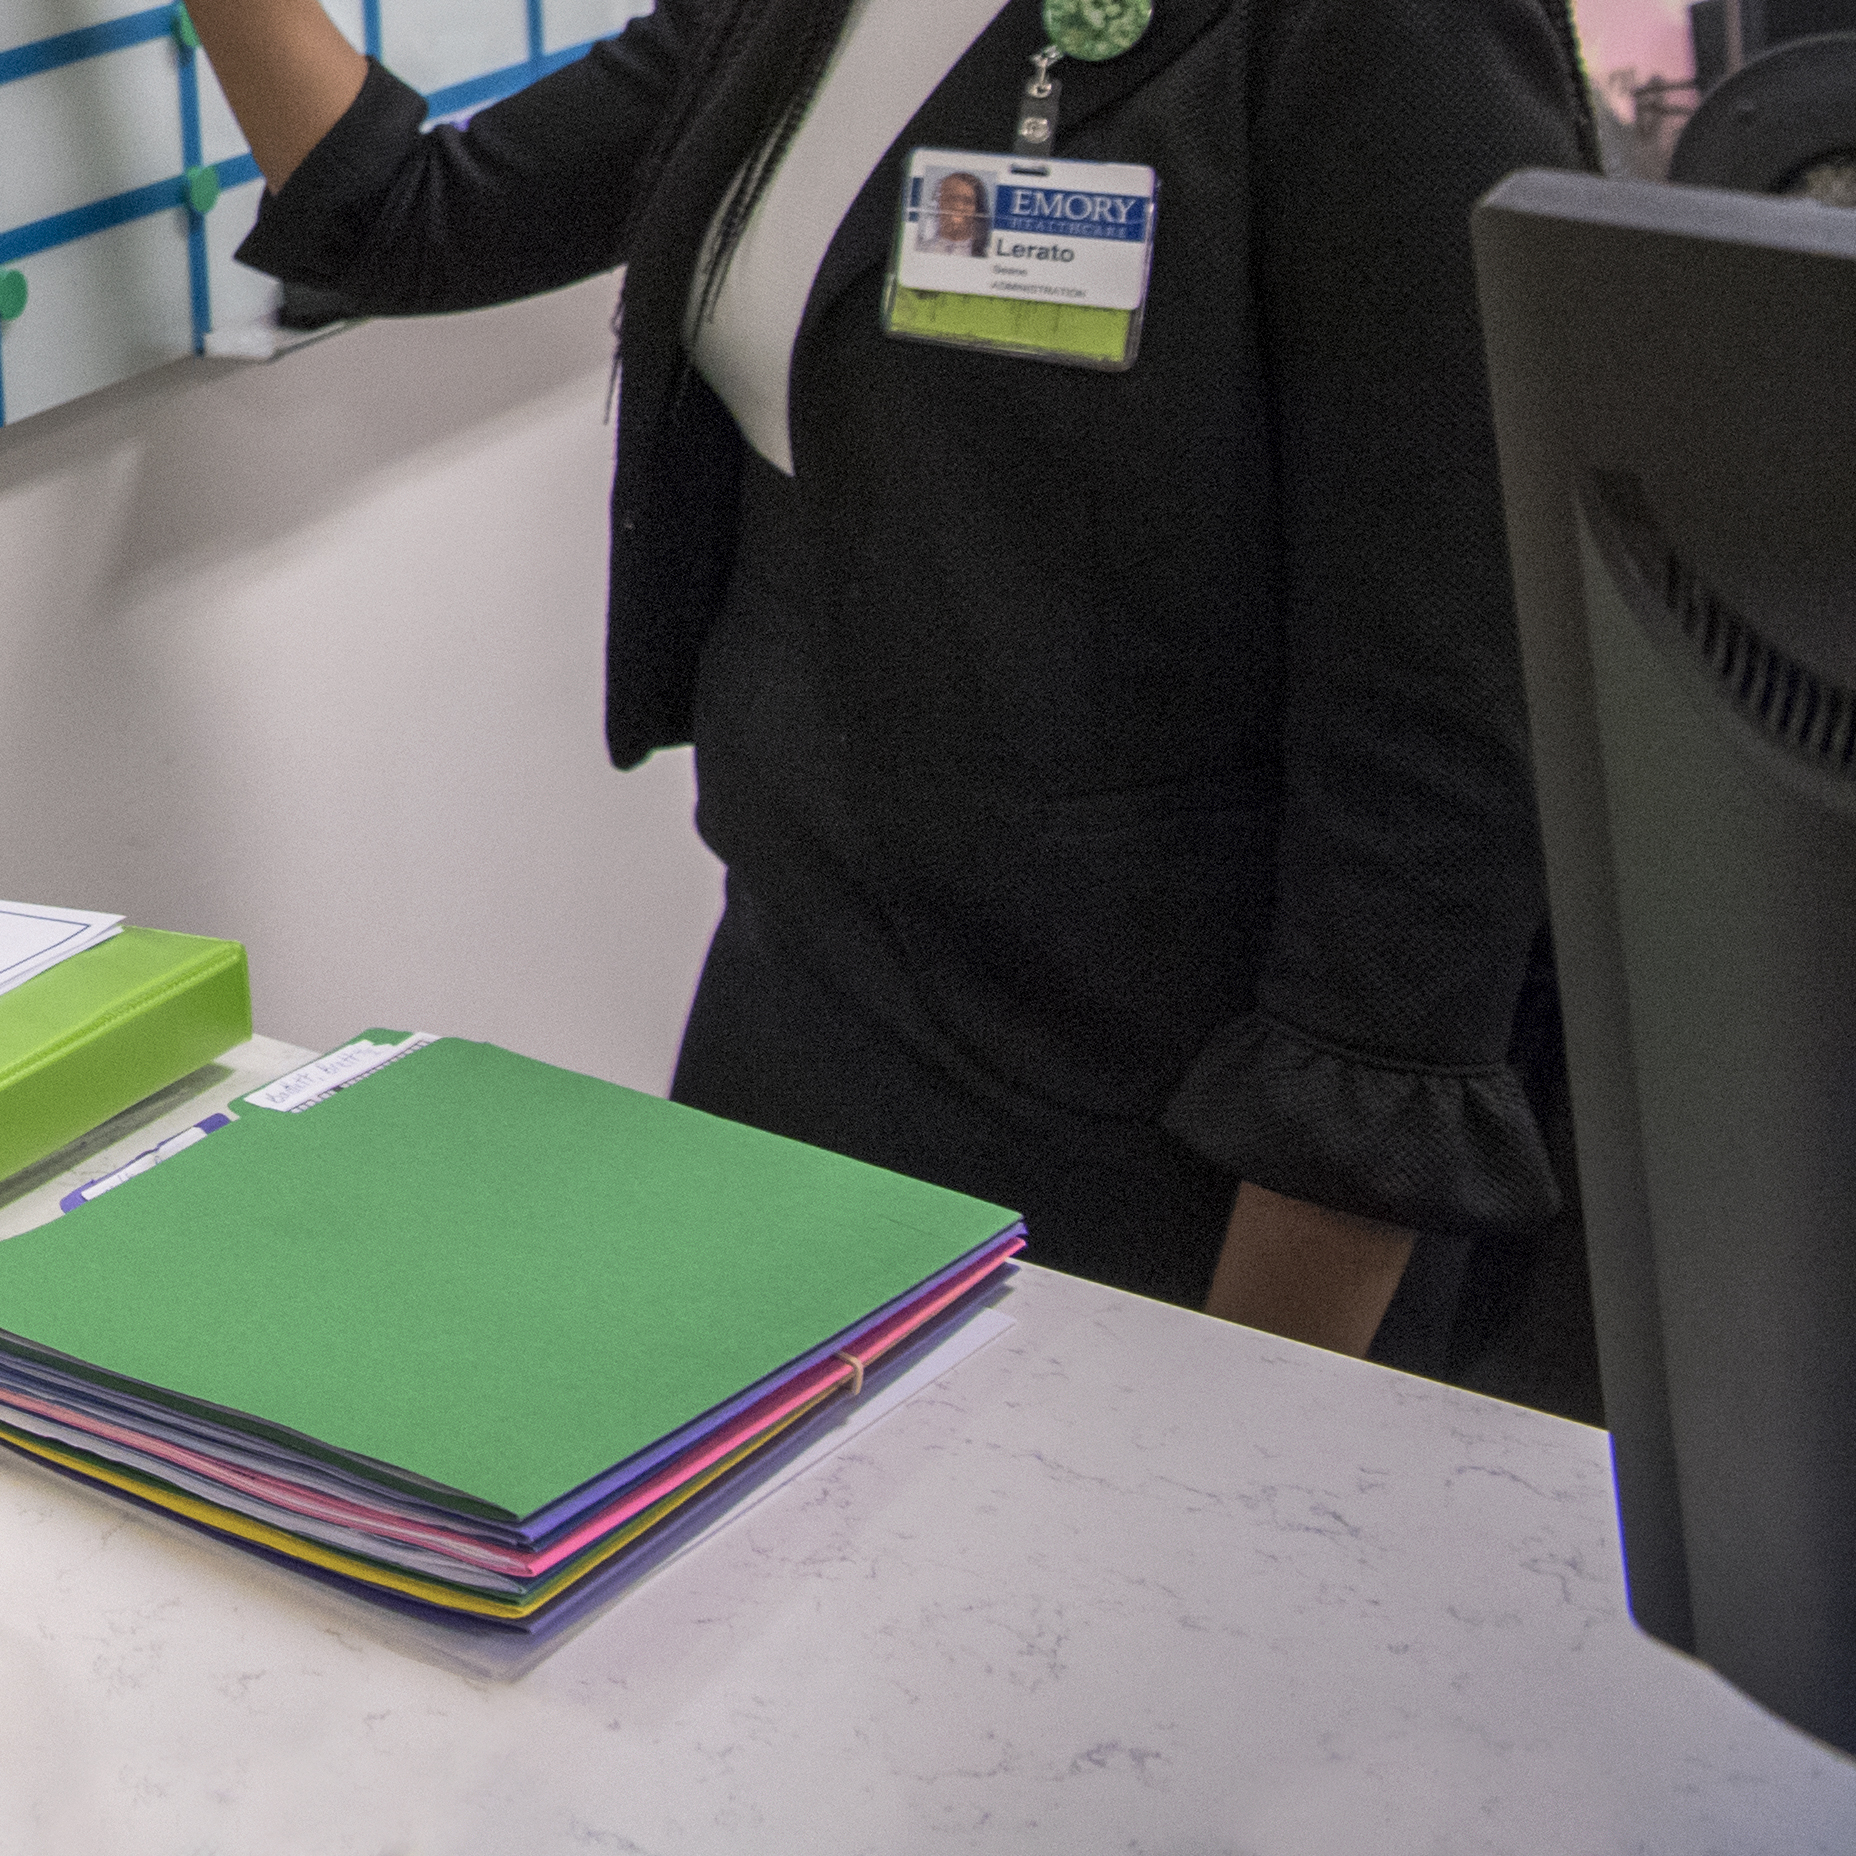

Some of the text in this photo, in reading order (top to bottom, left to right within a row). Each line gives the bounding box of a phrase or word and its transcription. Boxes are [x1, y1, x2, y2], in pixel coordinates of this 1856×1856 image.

[1010, 189, 1137, 225] EMORY
[1008, 217, 1127, 239] HEALTHCARE
[994, 238, 1076, 264] Lerato
